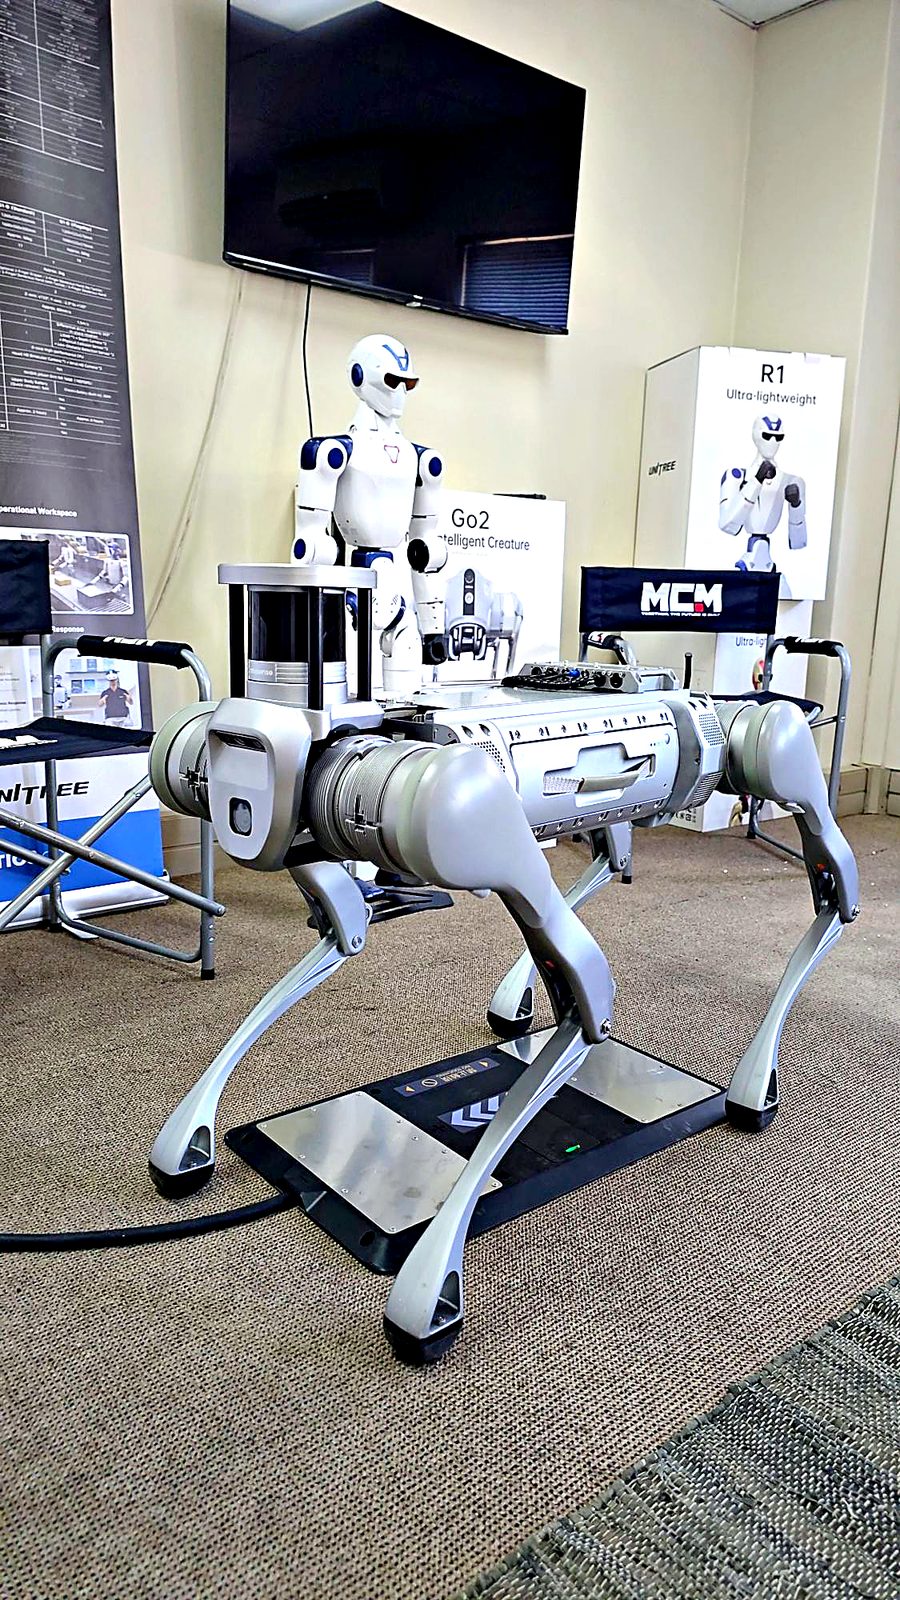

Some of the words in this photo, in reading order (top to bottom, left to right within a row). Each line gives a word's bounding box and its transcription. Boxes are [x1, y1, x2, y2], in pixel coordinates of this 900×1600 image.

[761, 364, 784, 384] R1
[726, 388, 817, 406] Ultra-lightweight
[648, 461, 677, 476] UNITREE
[37, 507, 78, 517] Workspace
[451, 508, 490, 530] Go2
[487, 536, 530, 550] Creature
[640, 582, 723, 613] MCM
